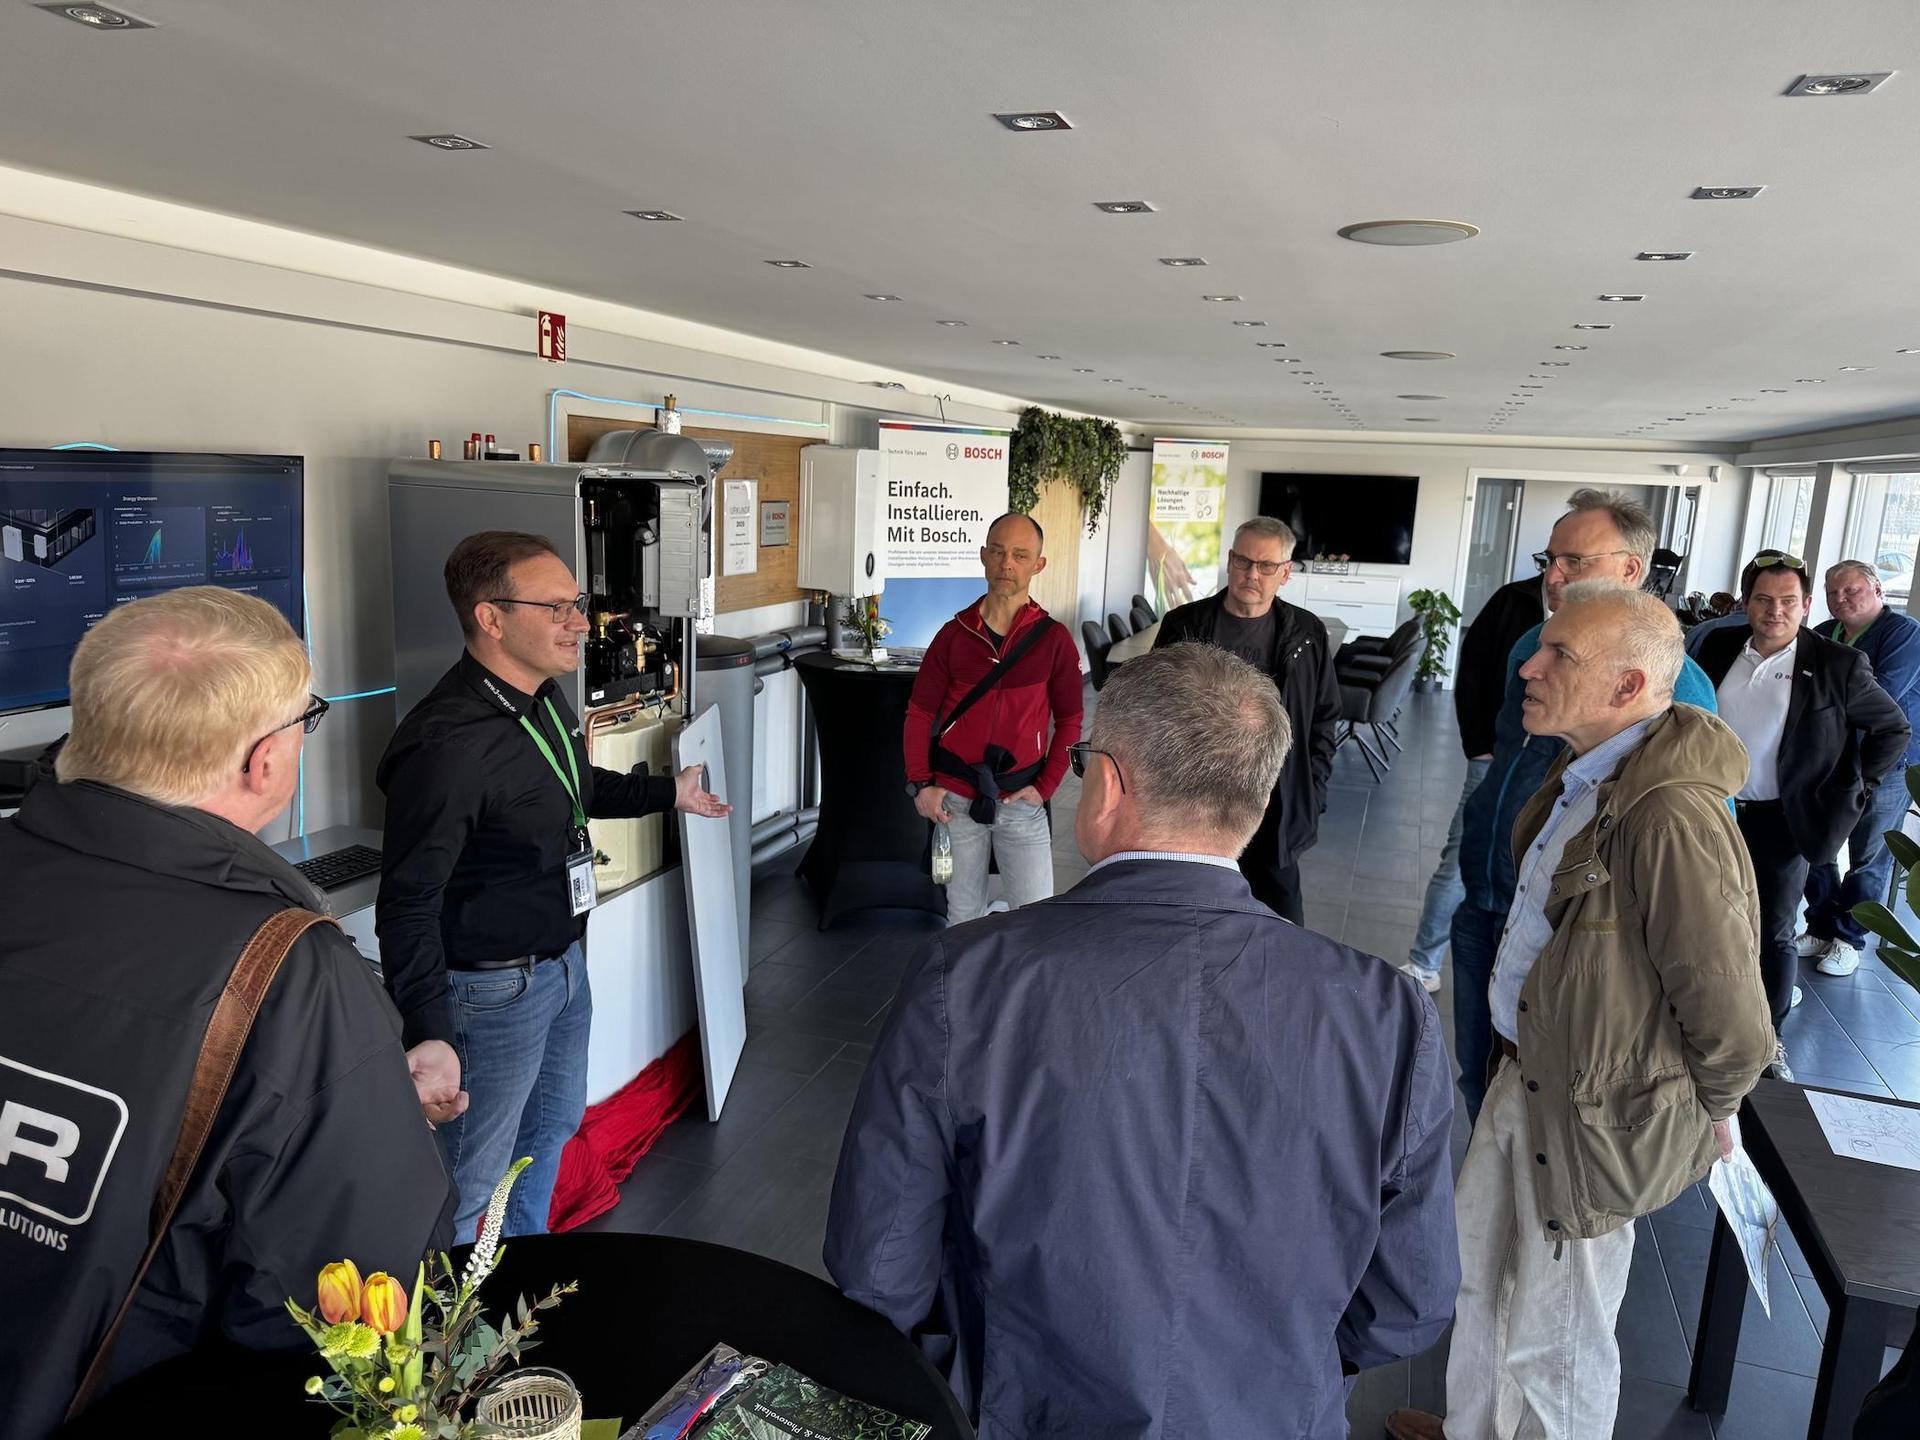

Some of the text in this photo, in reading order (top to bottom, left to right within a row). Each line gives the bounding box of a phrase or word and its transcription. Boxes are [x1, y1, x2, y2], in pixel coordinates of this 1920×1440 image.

[964, 447, 1002, 460] BOSCH
[1201, 451, 1224, 459] BOSCH
[888, 480, 953, 499] Einfach.
[888, 503, 984, 522] Installieren.
[888, 526, 972, 543] Mit Bosch.
[0, 1100, 80, 1183] R
[0, 1208, 68, 1251] LUTIONS
[754, 1402, 804, 1435] Photovoltaik
